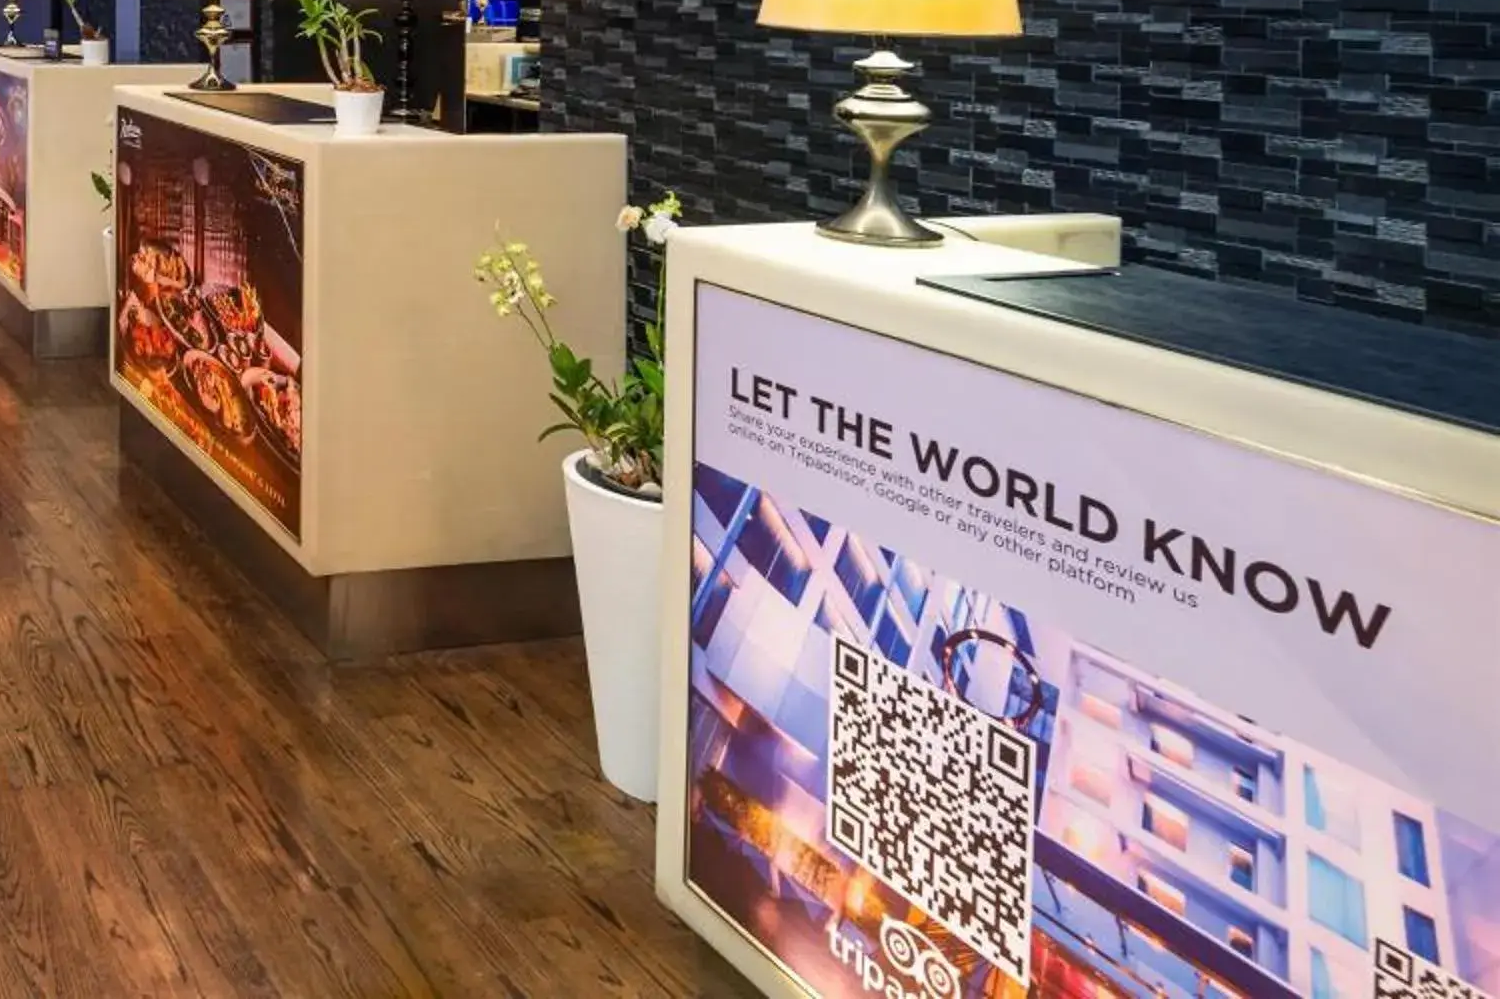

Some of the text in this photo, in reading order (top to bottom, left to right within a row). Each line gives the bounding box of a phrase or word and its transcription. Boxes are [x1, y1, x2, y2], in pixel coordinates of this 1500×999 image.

[727, 423, 767, 447] online
[769, 439, 785, 454] on
[874, 482, 931, 517] Google
[935, 509, 952, 526] or
[957, 516, 988, 543] any
[993, 532, 1042, 564] other
[1048, 555, 1136, 604] platform
[728, 405, 1200, 609] Share your experience with other travelers and review us
[731, 367, 1392, 649] LET THE WORLD KNOW
